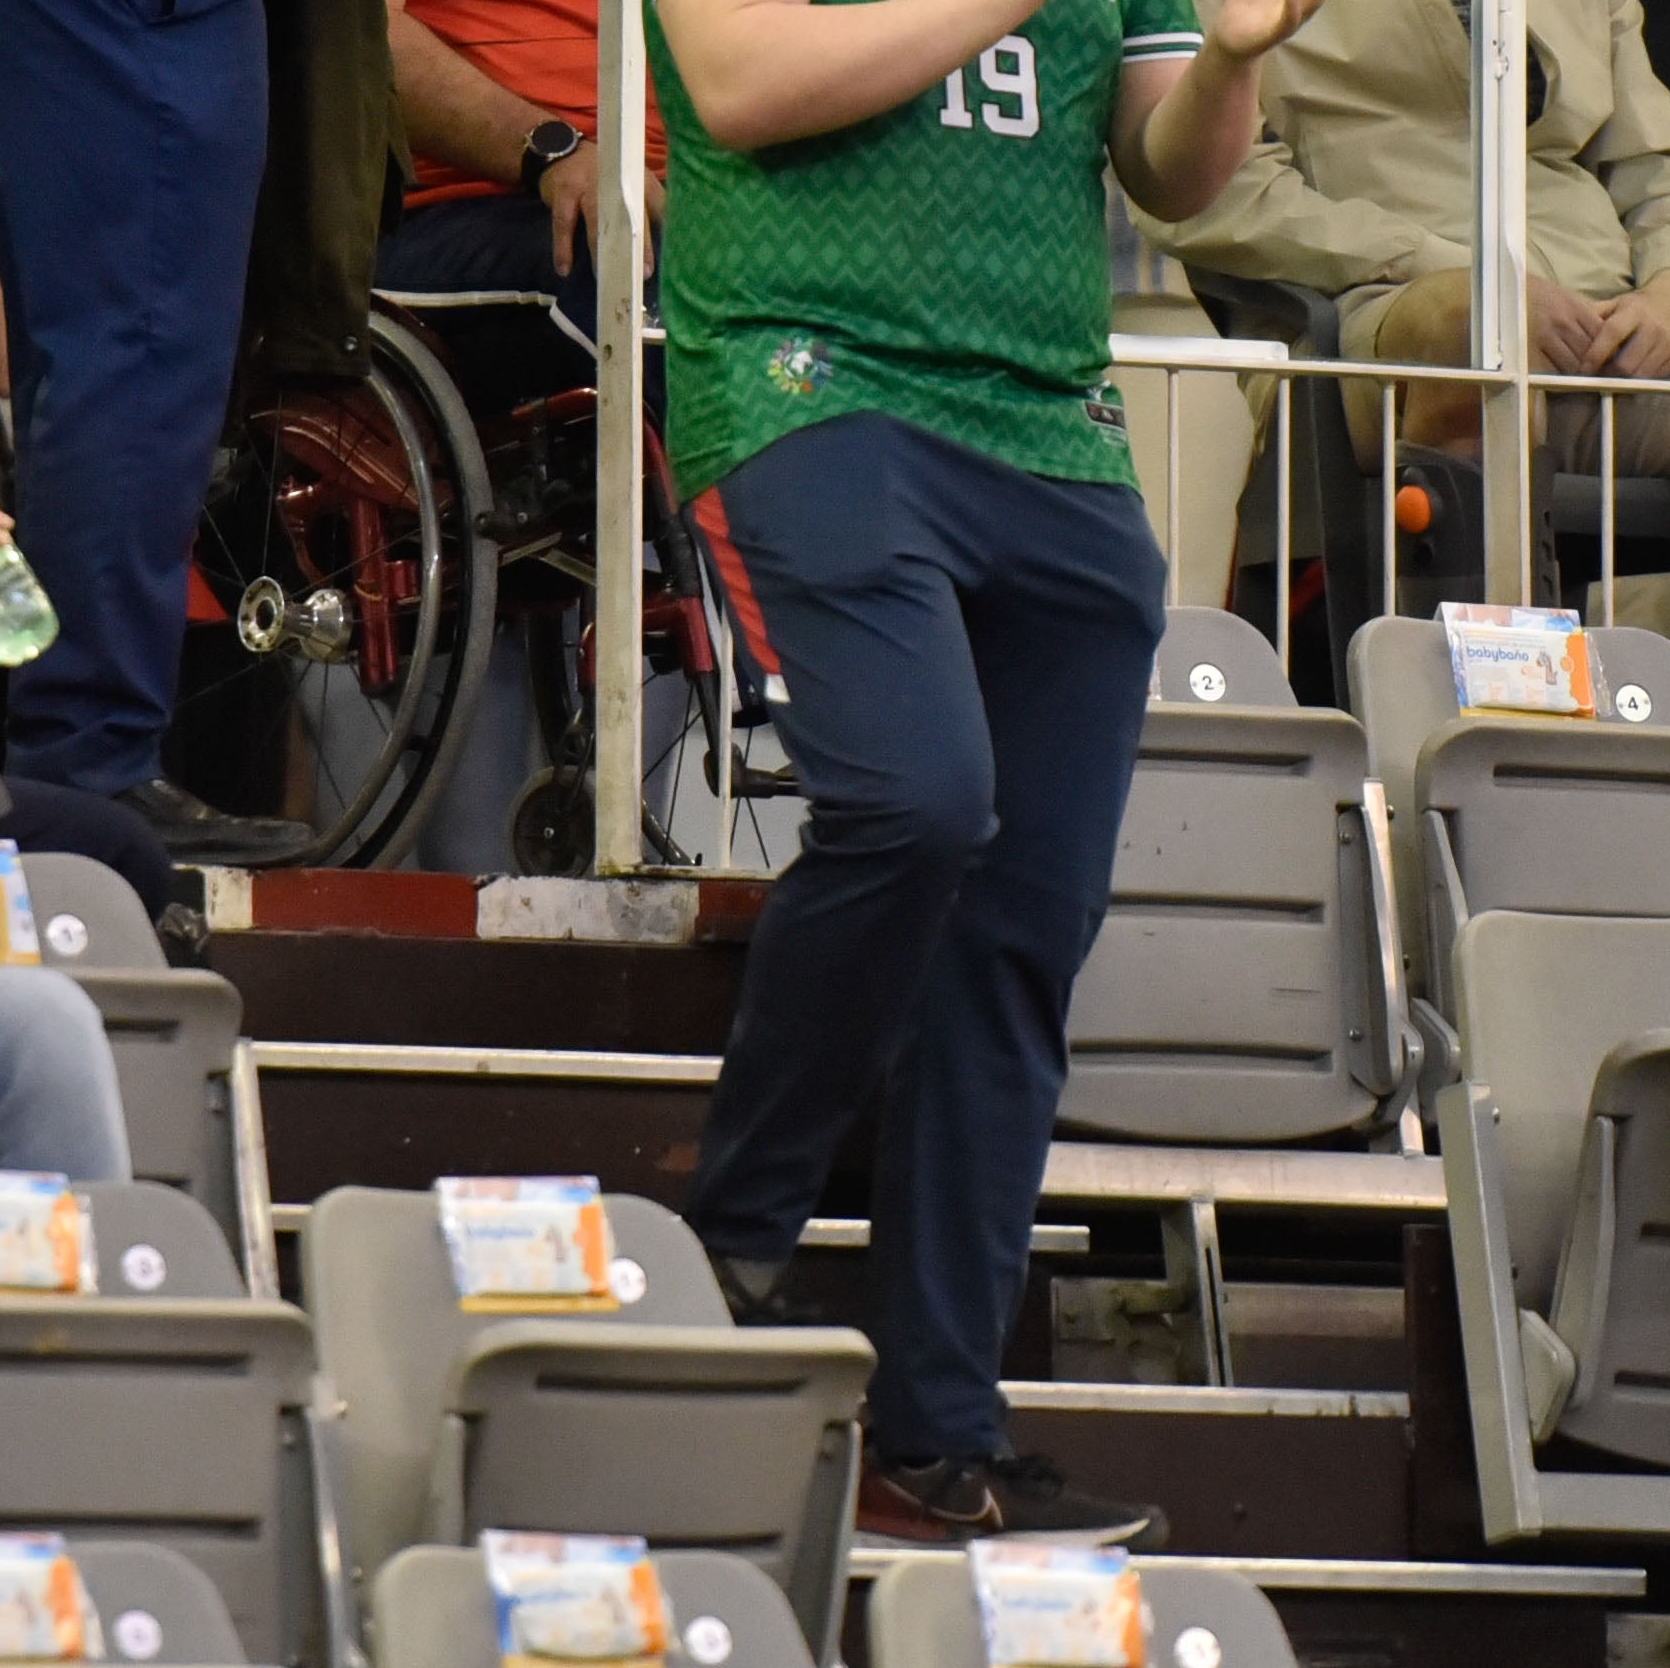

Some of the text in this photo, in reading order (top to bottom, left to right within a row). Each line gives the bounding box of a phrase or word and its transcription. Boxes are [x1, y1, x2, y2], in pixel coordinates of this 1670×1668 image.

[939, 34, 1040, 138] 19
[1466, 646, 1529, 663] babybaño
[1202, 675, 1214, 690] 2
[1628, 696, 1639, 710] 4
